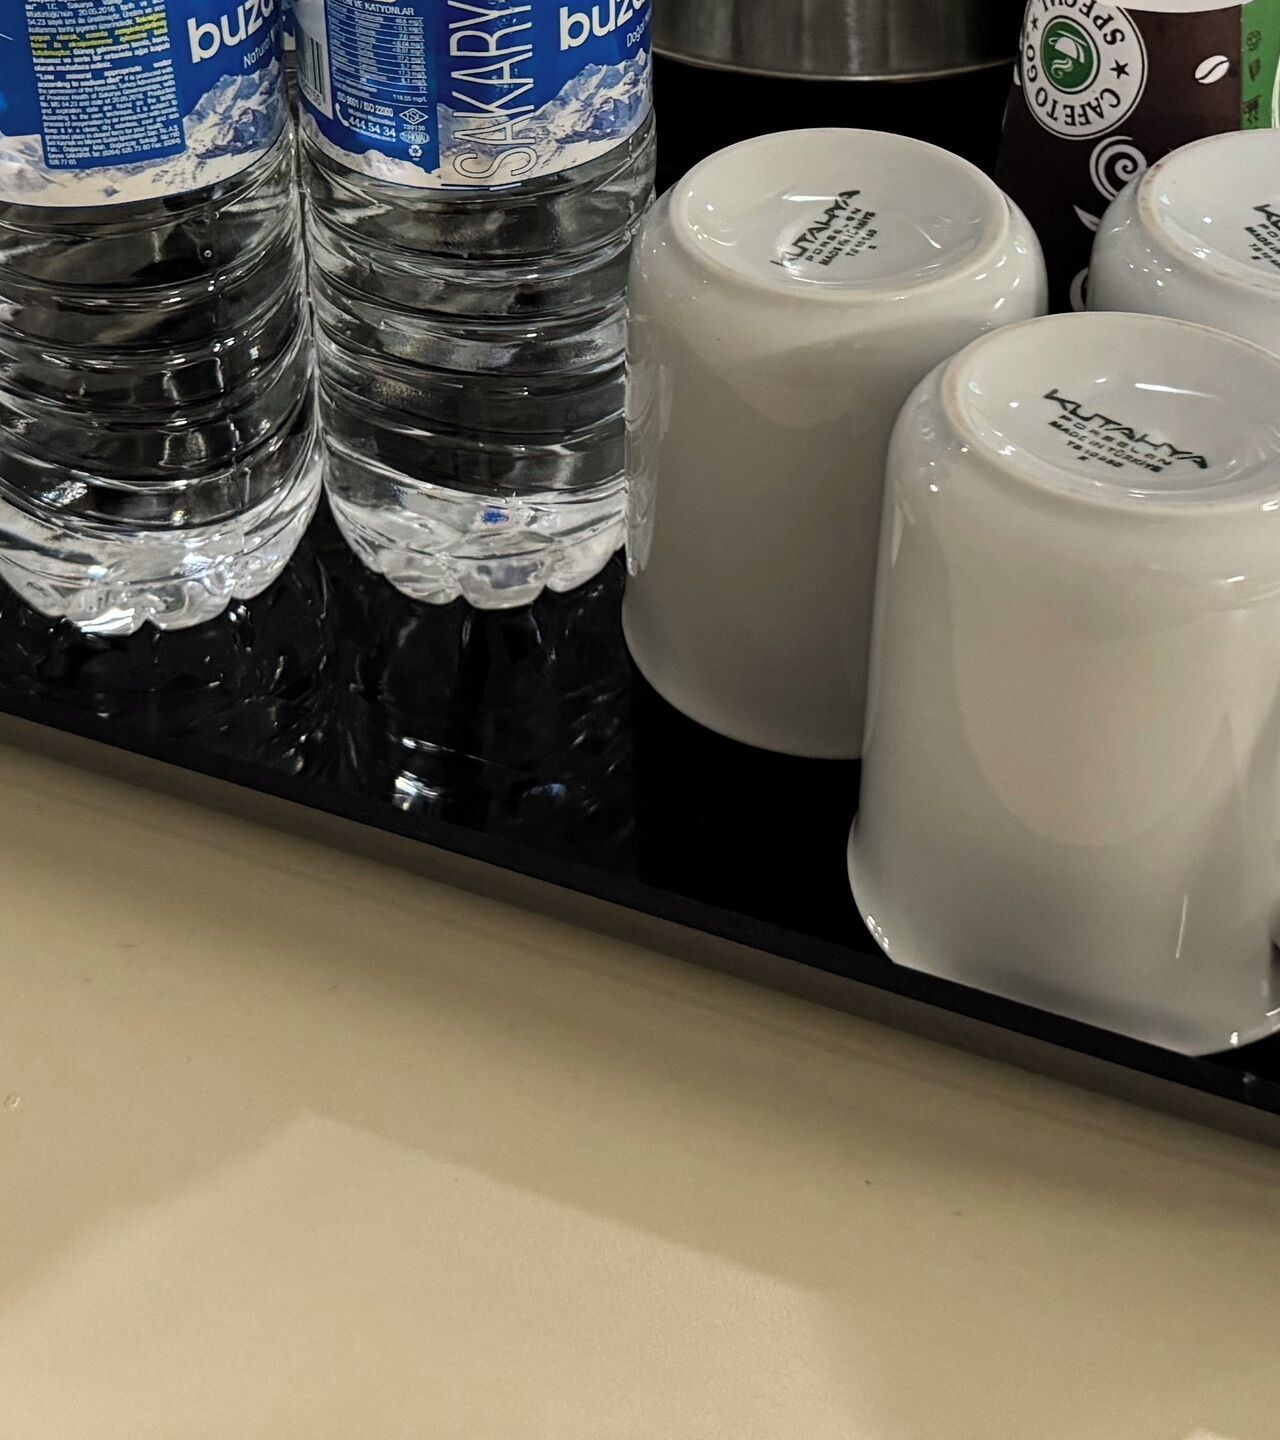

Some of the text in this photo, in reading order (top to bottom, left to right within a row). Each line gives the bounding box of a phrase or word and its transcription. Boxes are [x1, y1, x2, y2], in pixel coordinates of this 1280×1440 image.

[364, 2, 415, 16] KATYONLAR
[348, 116, 366, 130] 444
[367, 123, 381, 134] 54
[382, 126, 396, 138] 34
[1048, 420, 1089, 442] MADE
